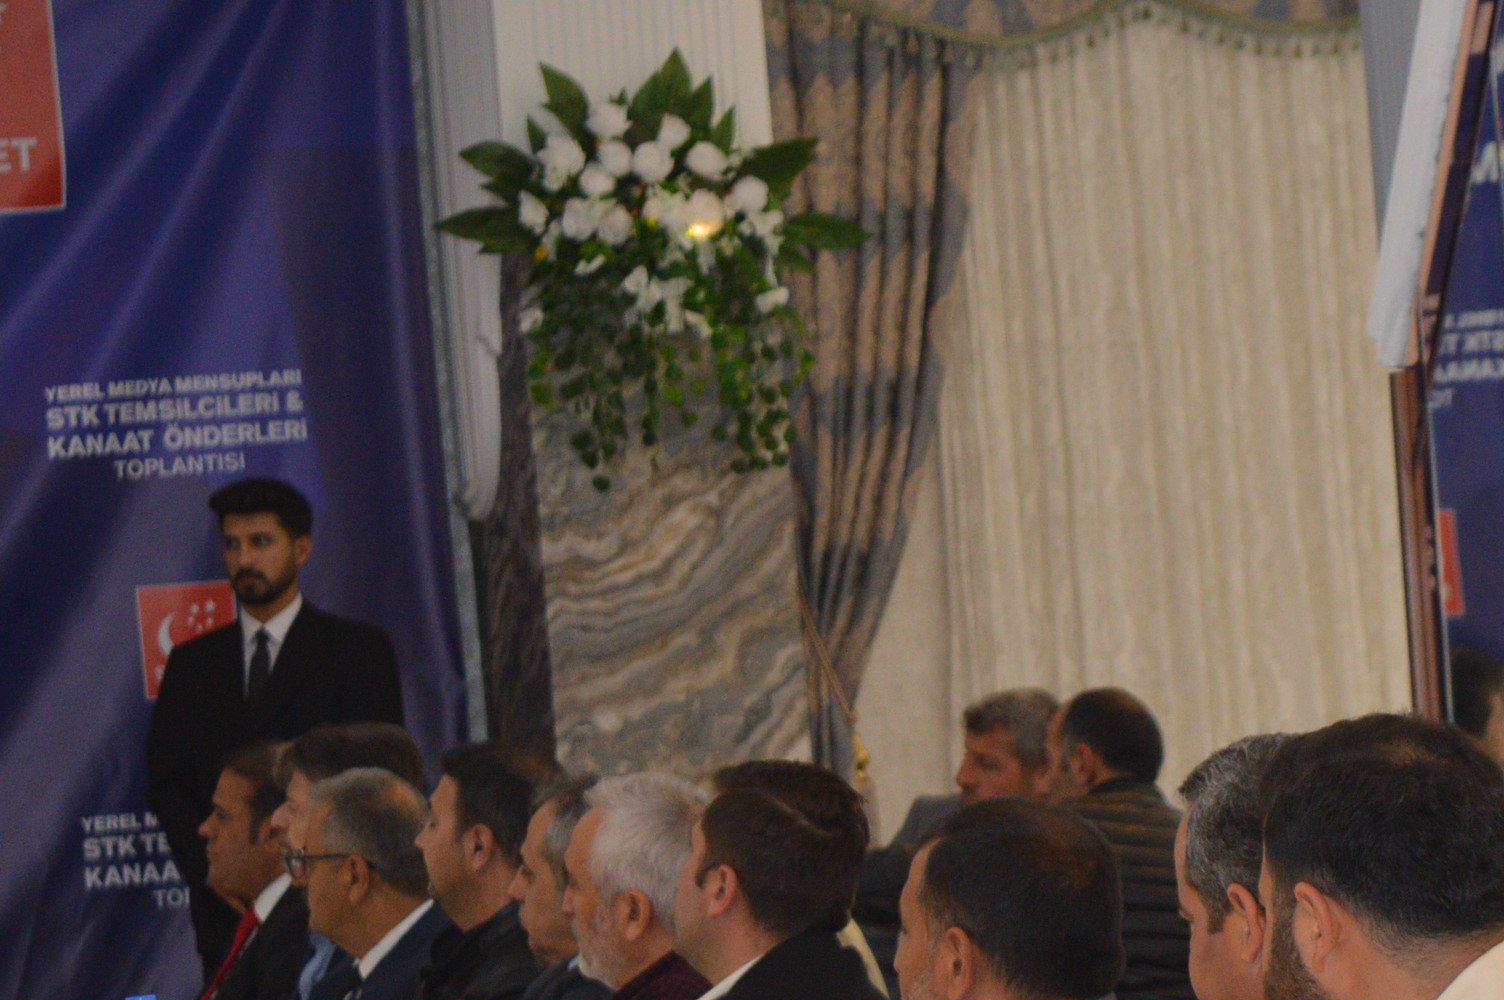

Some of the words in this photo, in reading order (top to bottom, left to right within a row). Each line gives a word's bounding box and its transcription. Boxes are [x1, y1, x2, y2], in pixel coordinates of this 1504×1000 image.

[45, 382, 105, 402] YEREL
[108, 376, 173, 398] MEDYA
[175, 368, 302, 394] MENSUPLARI
[47, 403, 101, 430] STK
[48, 428, 155, 460] KANAAT
[163, 416, 308, 450] ÖNDERLERİ
[114, 452, 246, 481] TOPLANTISI
[81, 812, 142, 832] YEREL
[83, 834, 137, 859] STK
